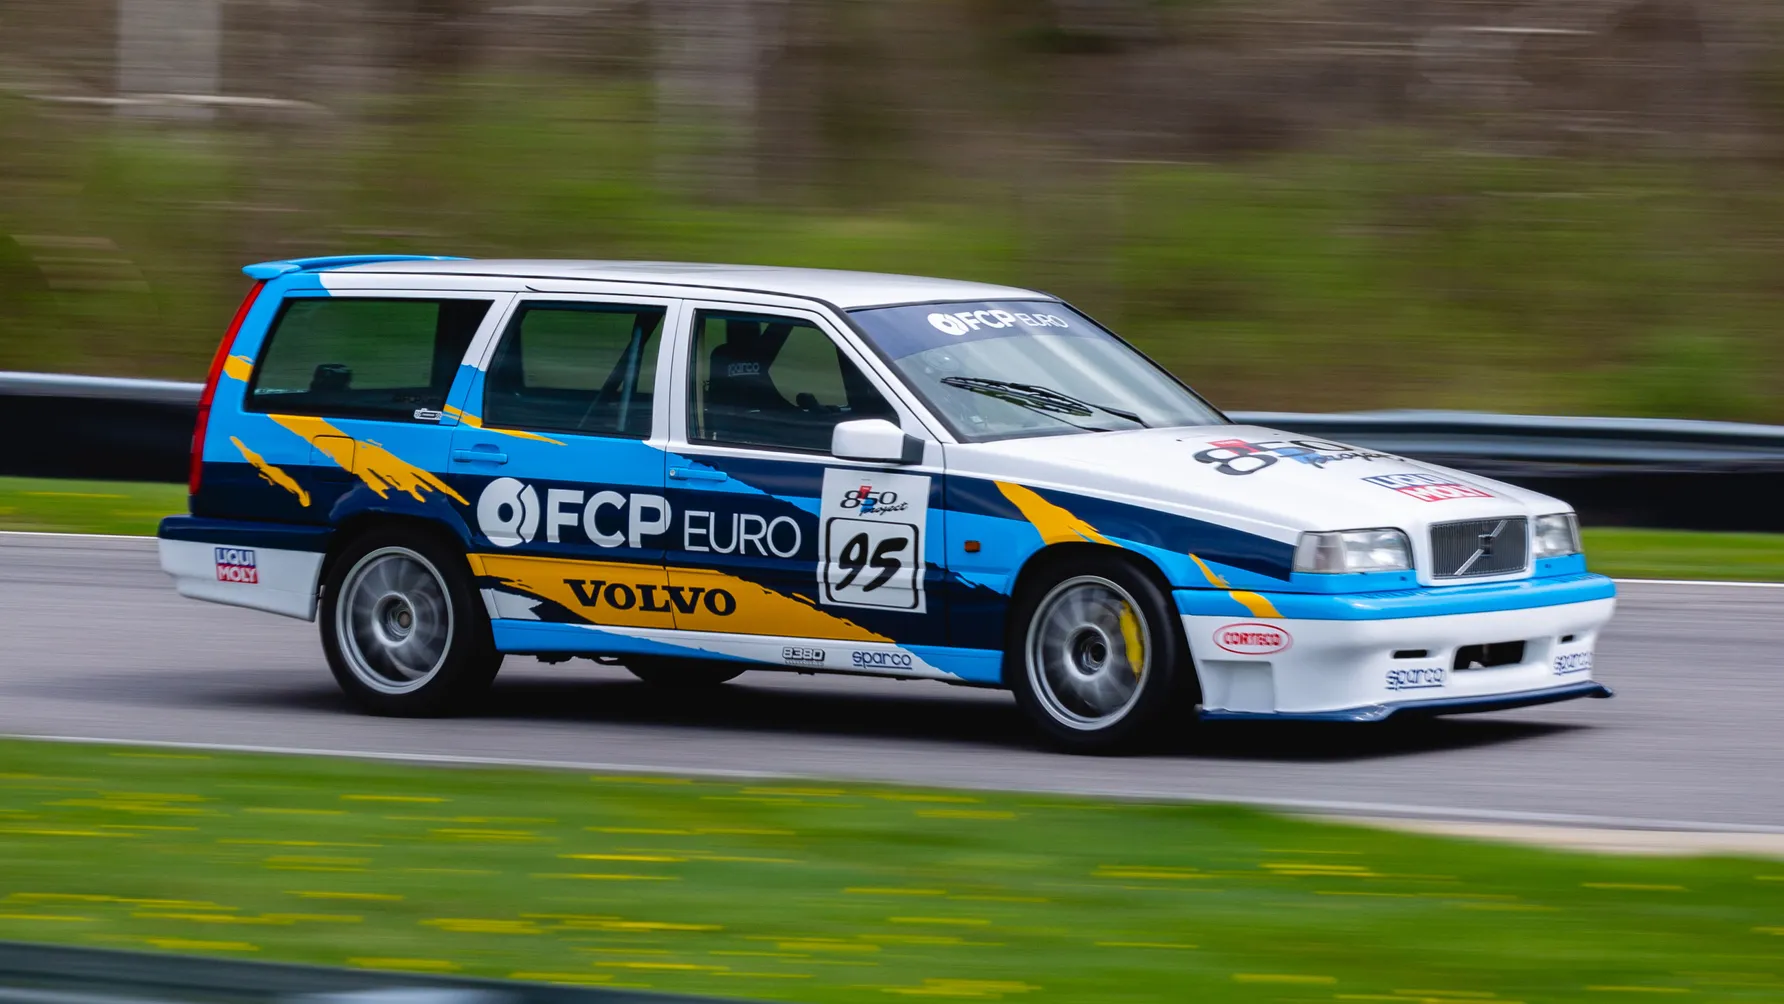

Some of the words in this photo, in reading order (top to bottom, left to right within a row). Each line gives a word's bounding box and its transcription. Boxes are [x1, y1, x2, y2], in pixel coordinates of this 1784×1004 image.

[957, 310, 1016, 331] FCP
[1014, 313, 1069, 328] EURO
[840, 490, 897, 508] 850
[859, 502, 908, 516] project
[547, 490, 672, 548] FCP
[684, 509, 801, 558] EURO
[216, 549, 254, 566] LIQUI
[835, 532, 908, 592] 95
[217, 565, 257, 583] MOLY
[563, 578, 737, 616] VOLVO
[1223, 632, 1281, 646] CORTECO
[852, 651, 912, 669] sparco
[1385, 668, 1444, 690] sparco
